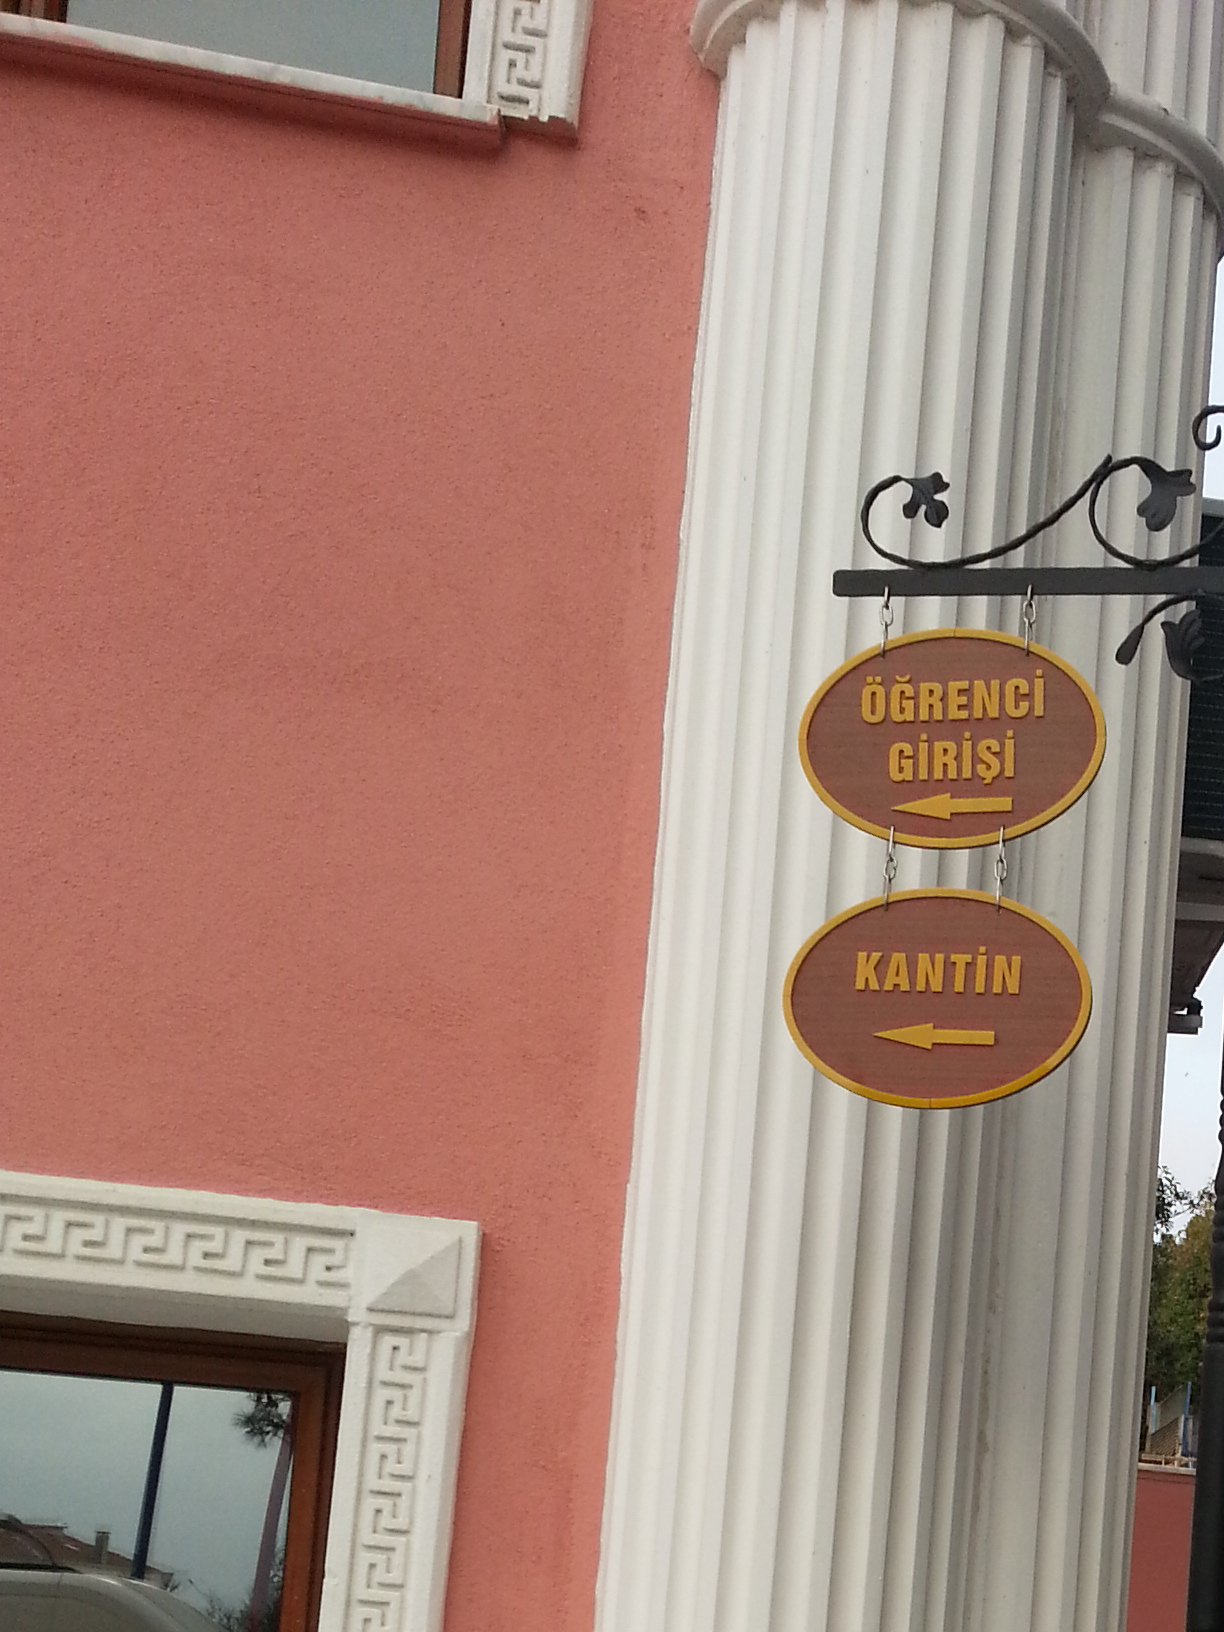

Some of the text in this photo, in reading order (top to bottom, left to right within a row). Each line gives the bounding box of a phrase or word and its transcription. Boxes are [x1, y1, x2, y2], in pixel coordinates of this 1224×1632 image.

[861, 669, 1045, 724] ÖĞRENCİ
[888, 729, 1016, 784] GİRİŞİ
[854, 946, 1022, 995] KANTİN
